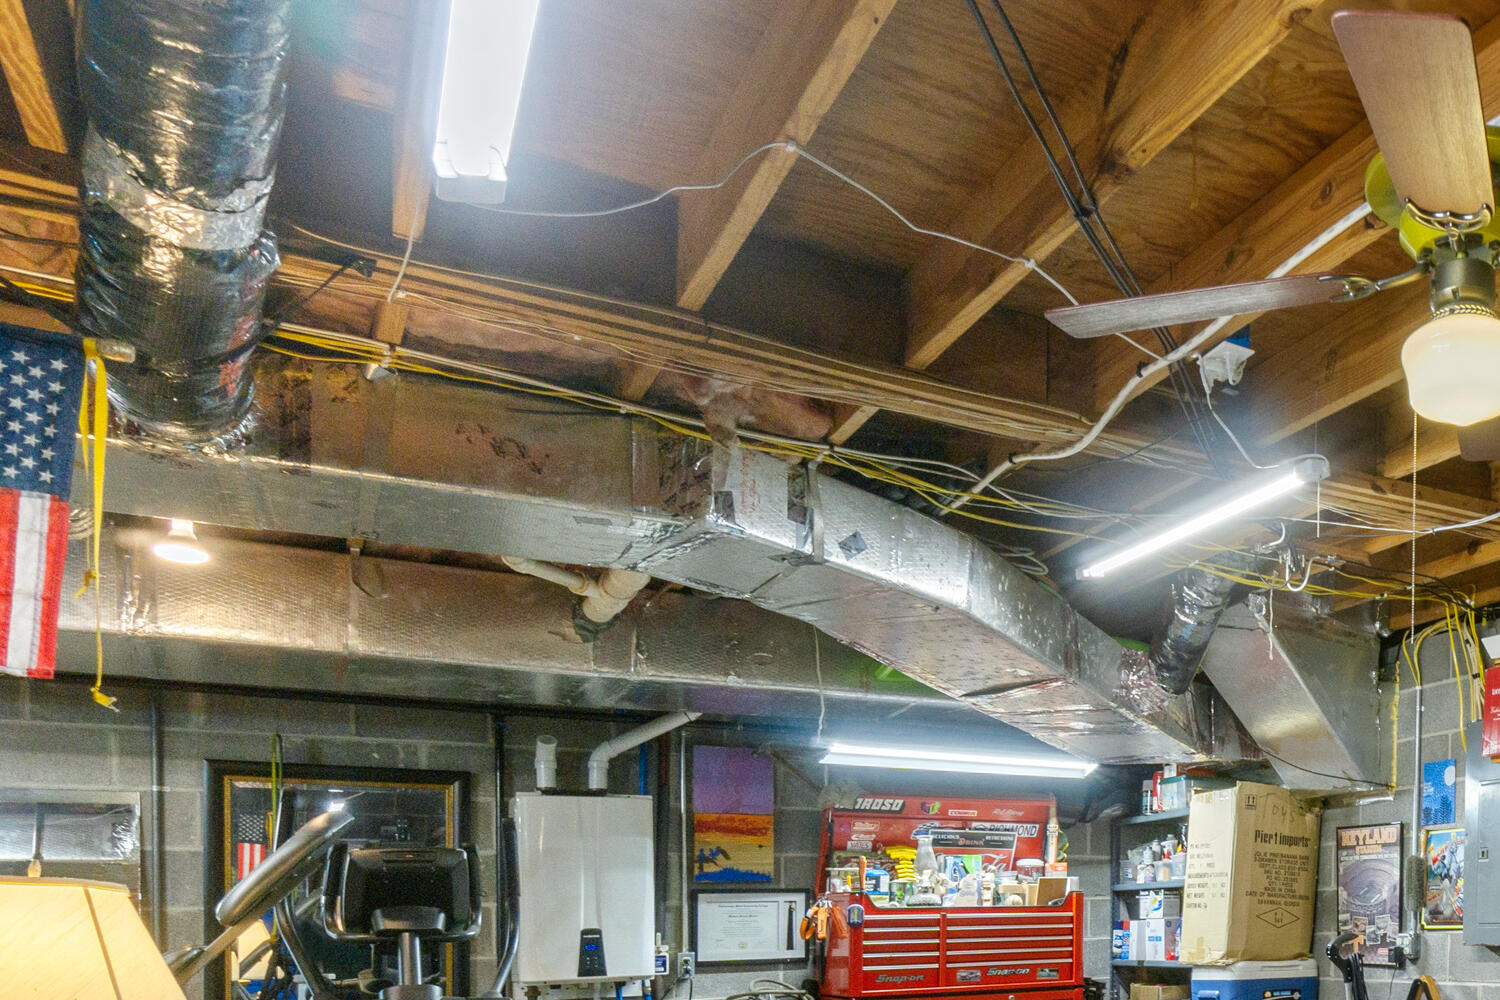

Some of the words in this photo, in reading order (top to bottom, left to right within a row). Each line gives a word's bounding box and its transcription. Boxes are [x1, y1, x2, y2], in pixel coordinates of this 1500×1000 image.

[1254, 829, 1274, 844] Pier
[1274, 832, 1278, 845] 1
[1279, 832, 1309, 848] imports
[986, 967, 1030, 976] Snap-on
[875, 974, 925, 984] Snap-on
